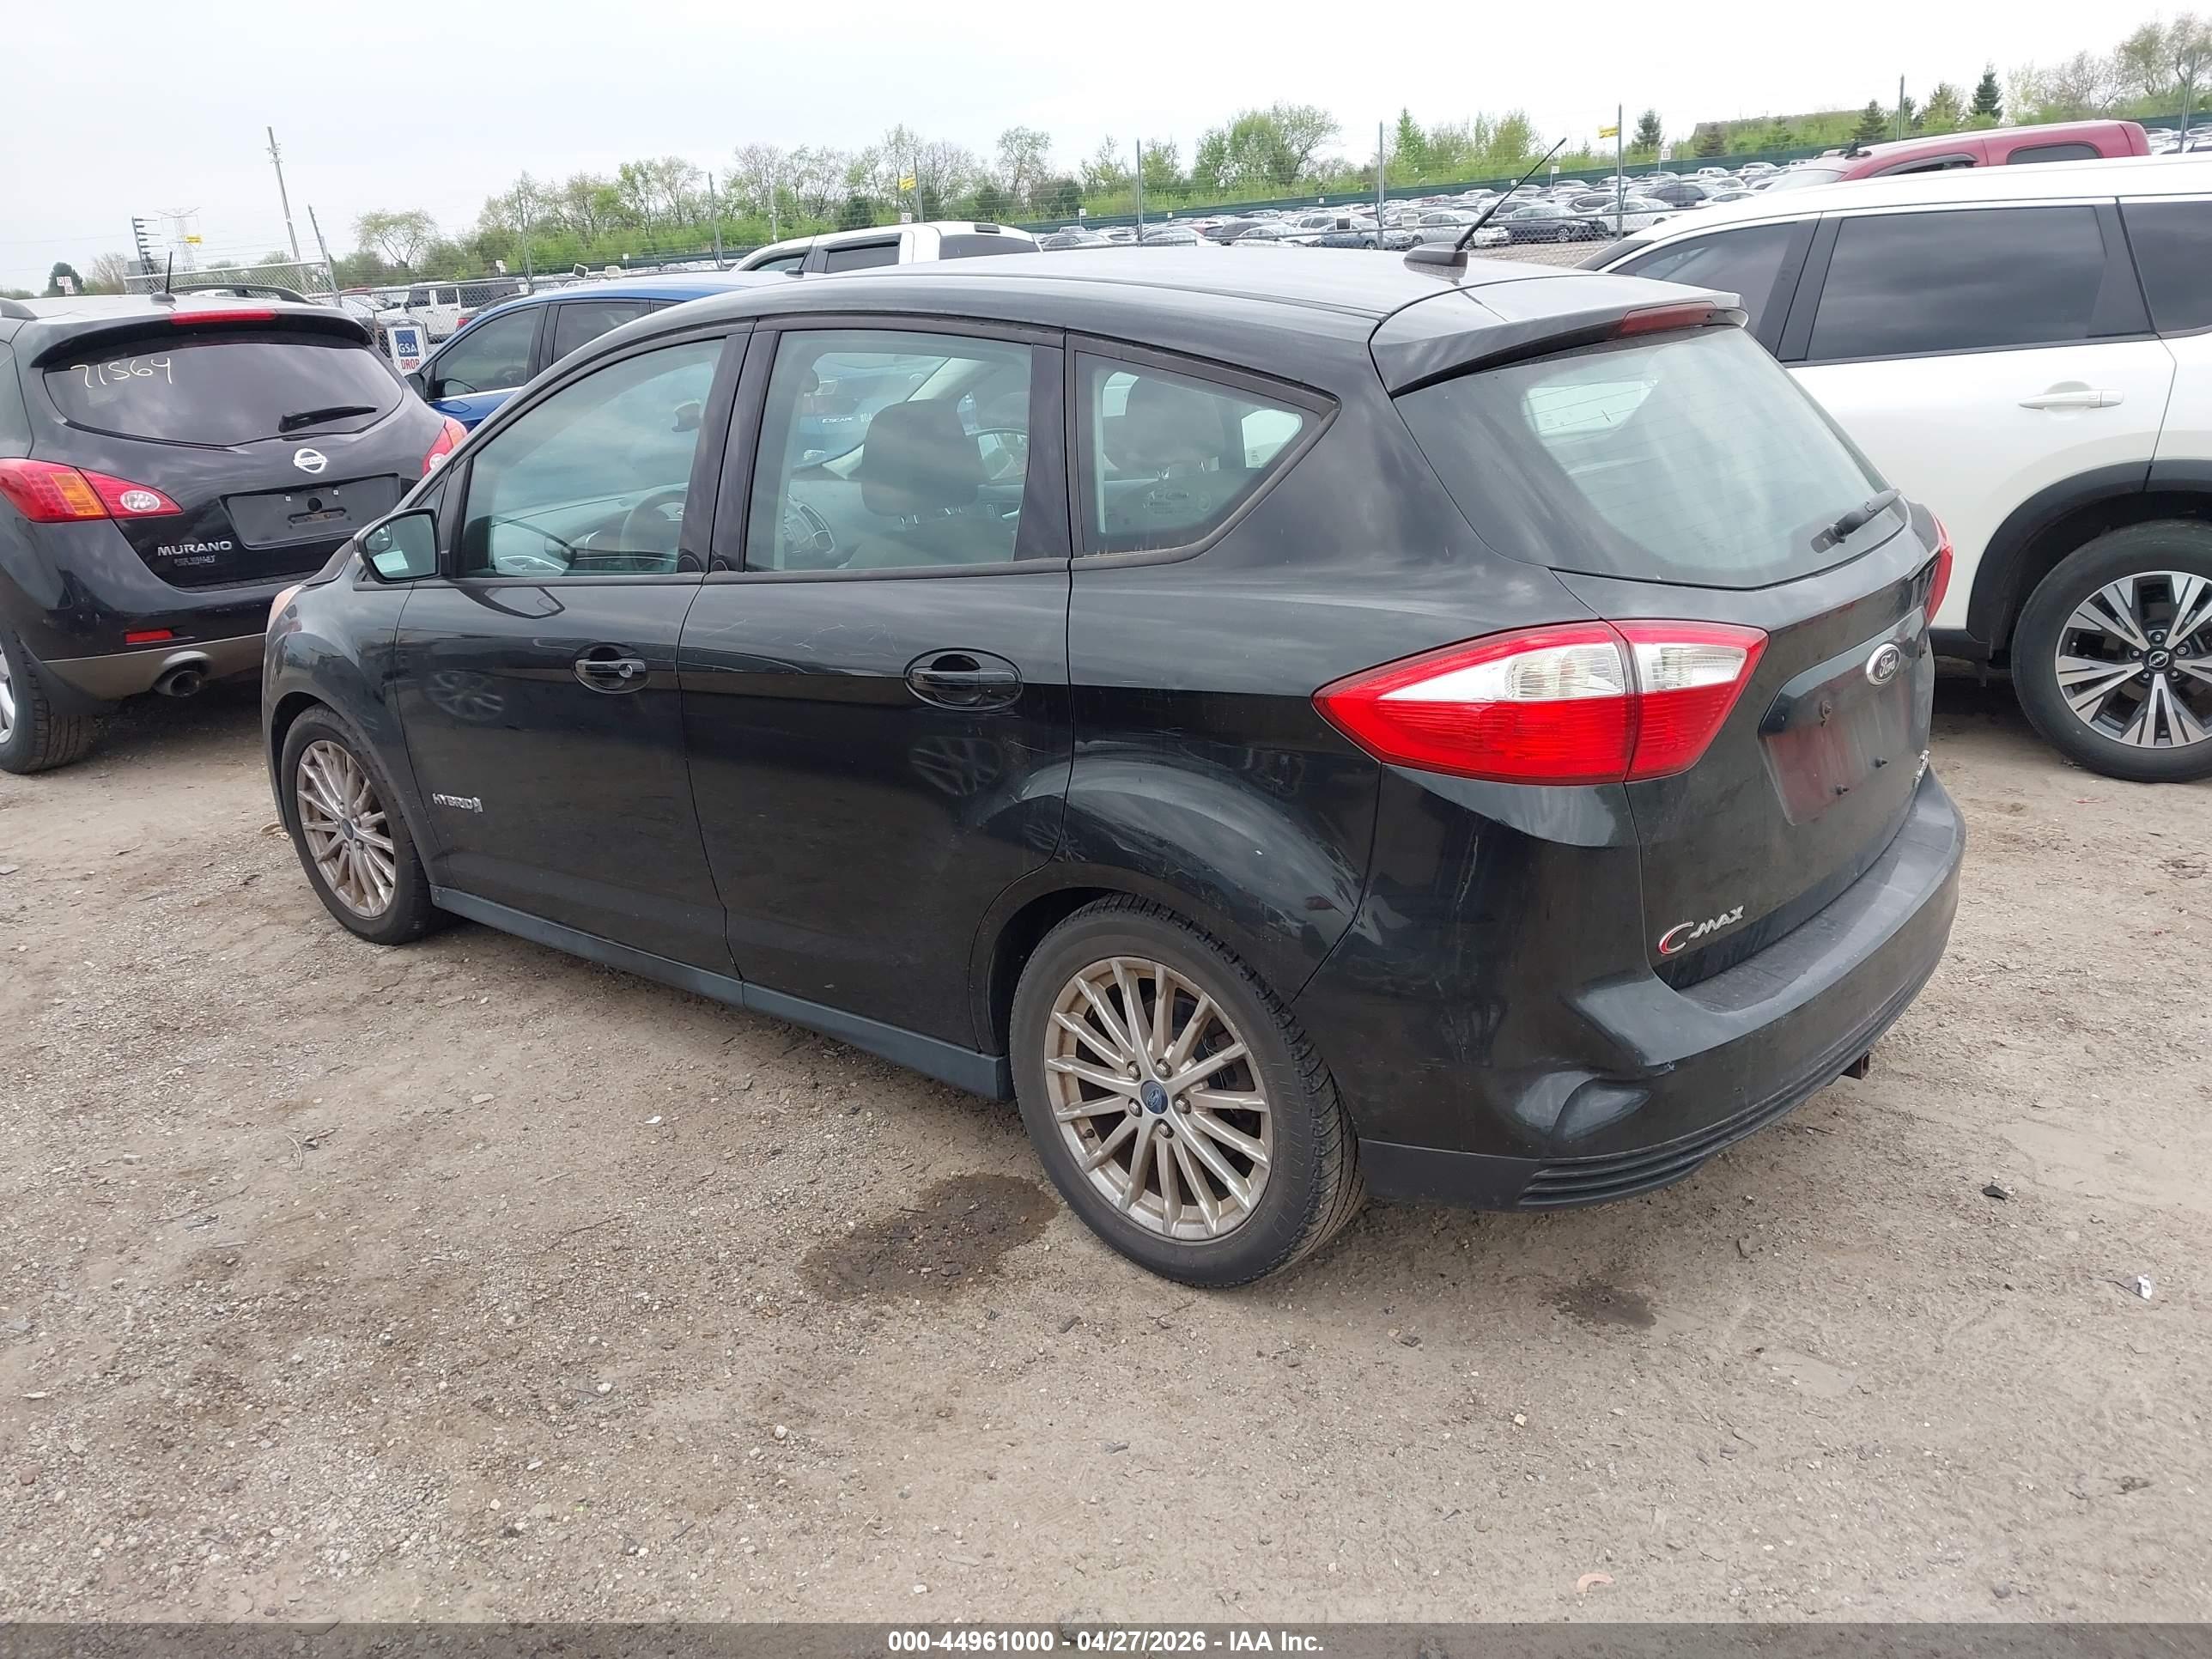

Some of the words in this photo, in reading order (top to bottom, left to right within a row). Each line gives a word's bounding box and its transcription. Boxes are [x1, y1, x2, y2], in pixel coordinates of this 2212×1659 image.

[398, 343, 417, 354] GSA
[400, 358, 420, 370] DROP
[70, 357, 173, 388] 71564
[157, 541, 232, 556] MURANO
